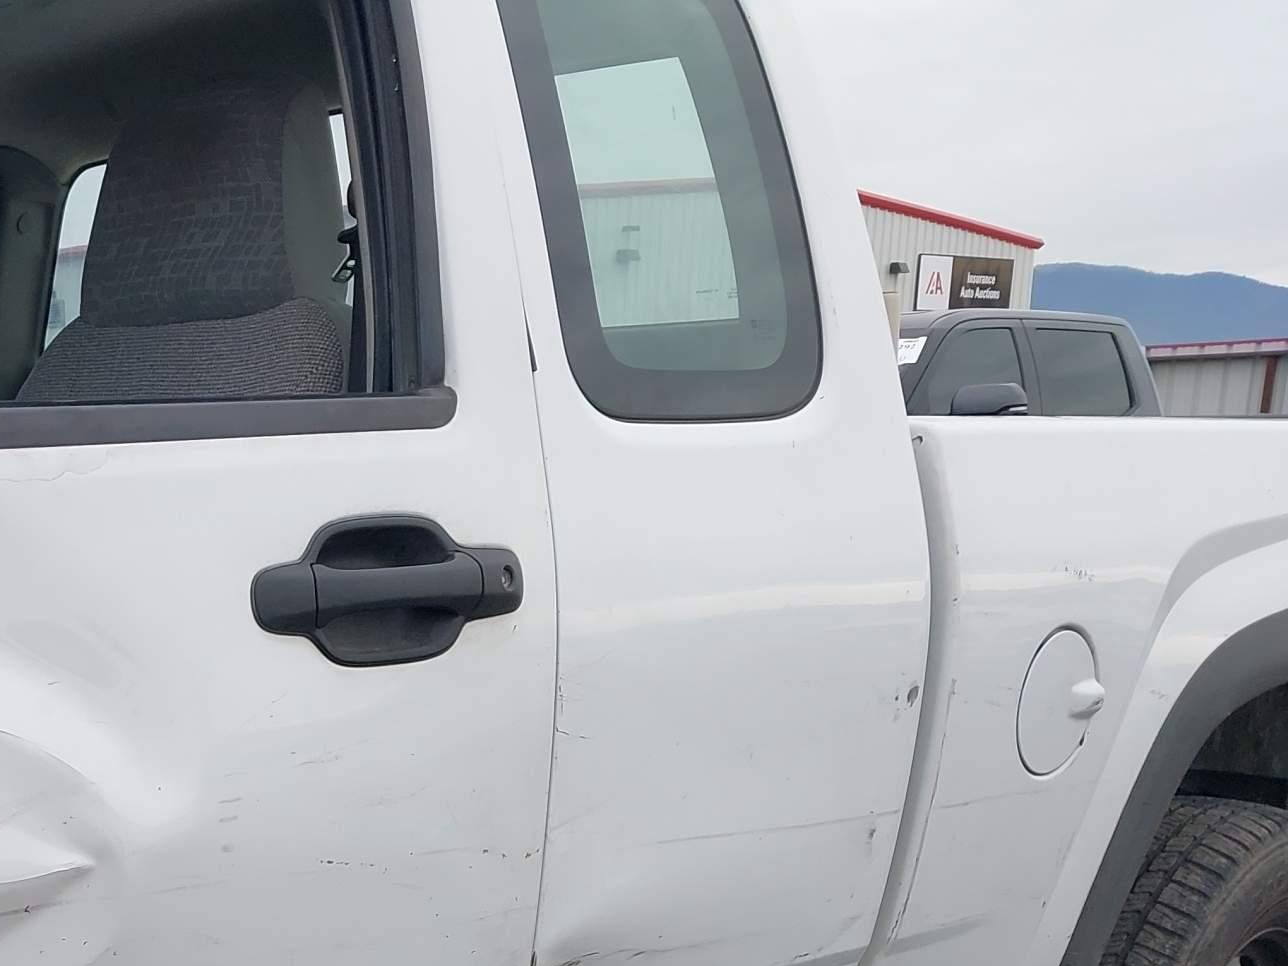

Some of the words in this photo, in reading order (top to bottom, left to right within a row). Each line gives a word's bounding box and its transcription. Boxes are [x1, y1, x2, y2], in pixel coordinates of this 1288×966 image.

[967, 271, 996, 285] Insurance
[960, 285, 975, 299] Auto
[975, 286, 1001, 300] Auctions
